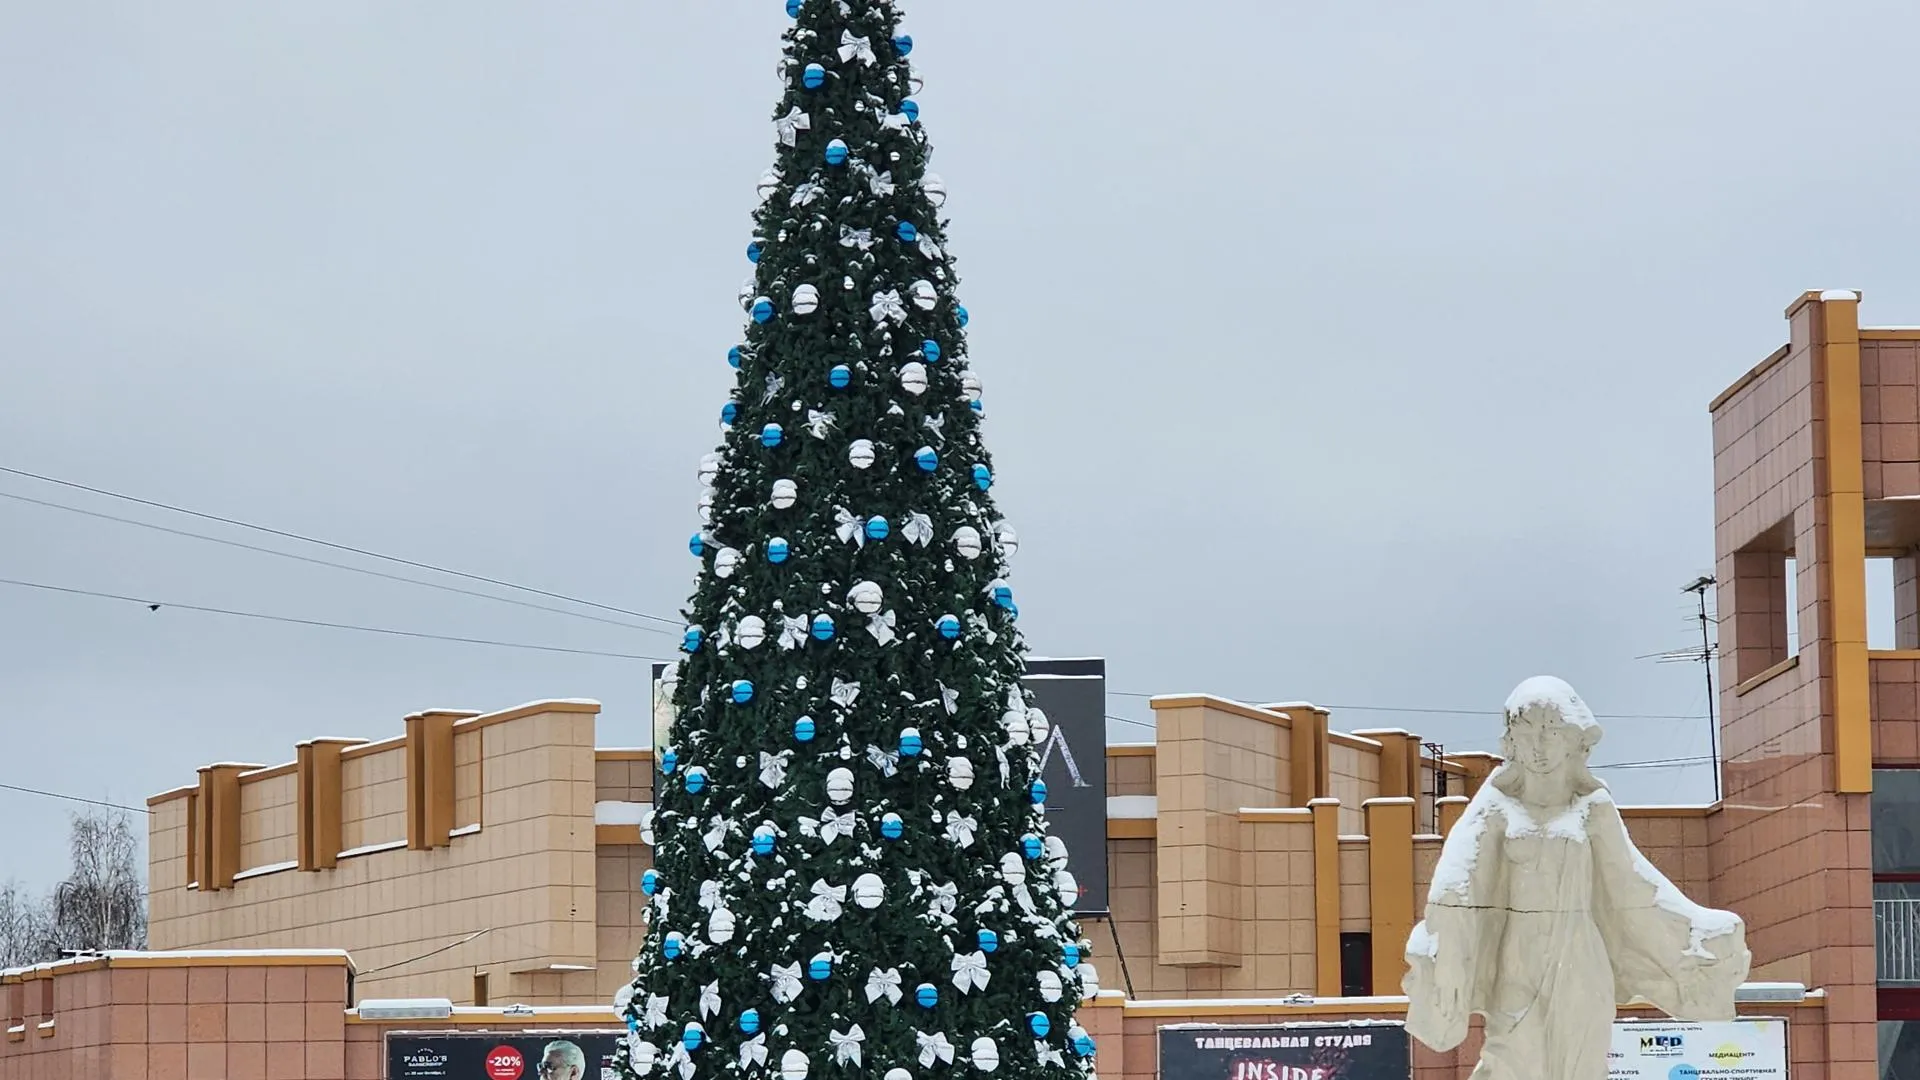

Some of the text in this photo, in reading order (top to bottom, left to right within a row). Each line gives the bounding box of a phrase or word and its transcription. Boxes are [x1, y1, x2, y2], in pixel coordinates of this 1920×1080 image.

[1194, 1034, 1372, 1050] ТАНЦЕВАЛЬНАЯ СТУДИЯ
[1709, 1051, 1755, 1059] МЕДИАЦЕНТР
[488, 1056, 521, 1066] -20%
